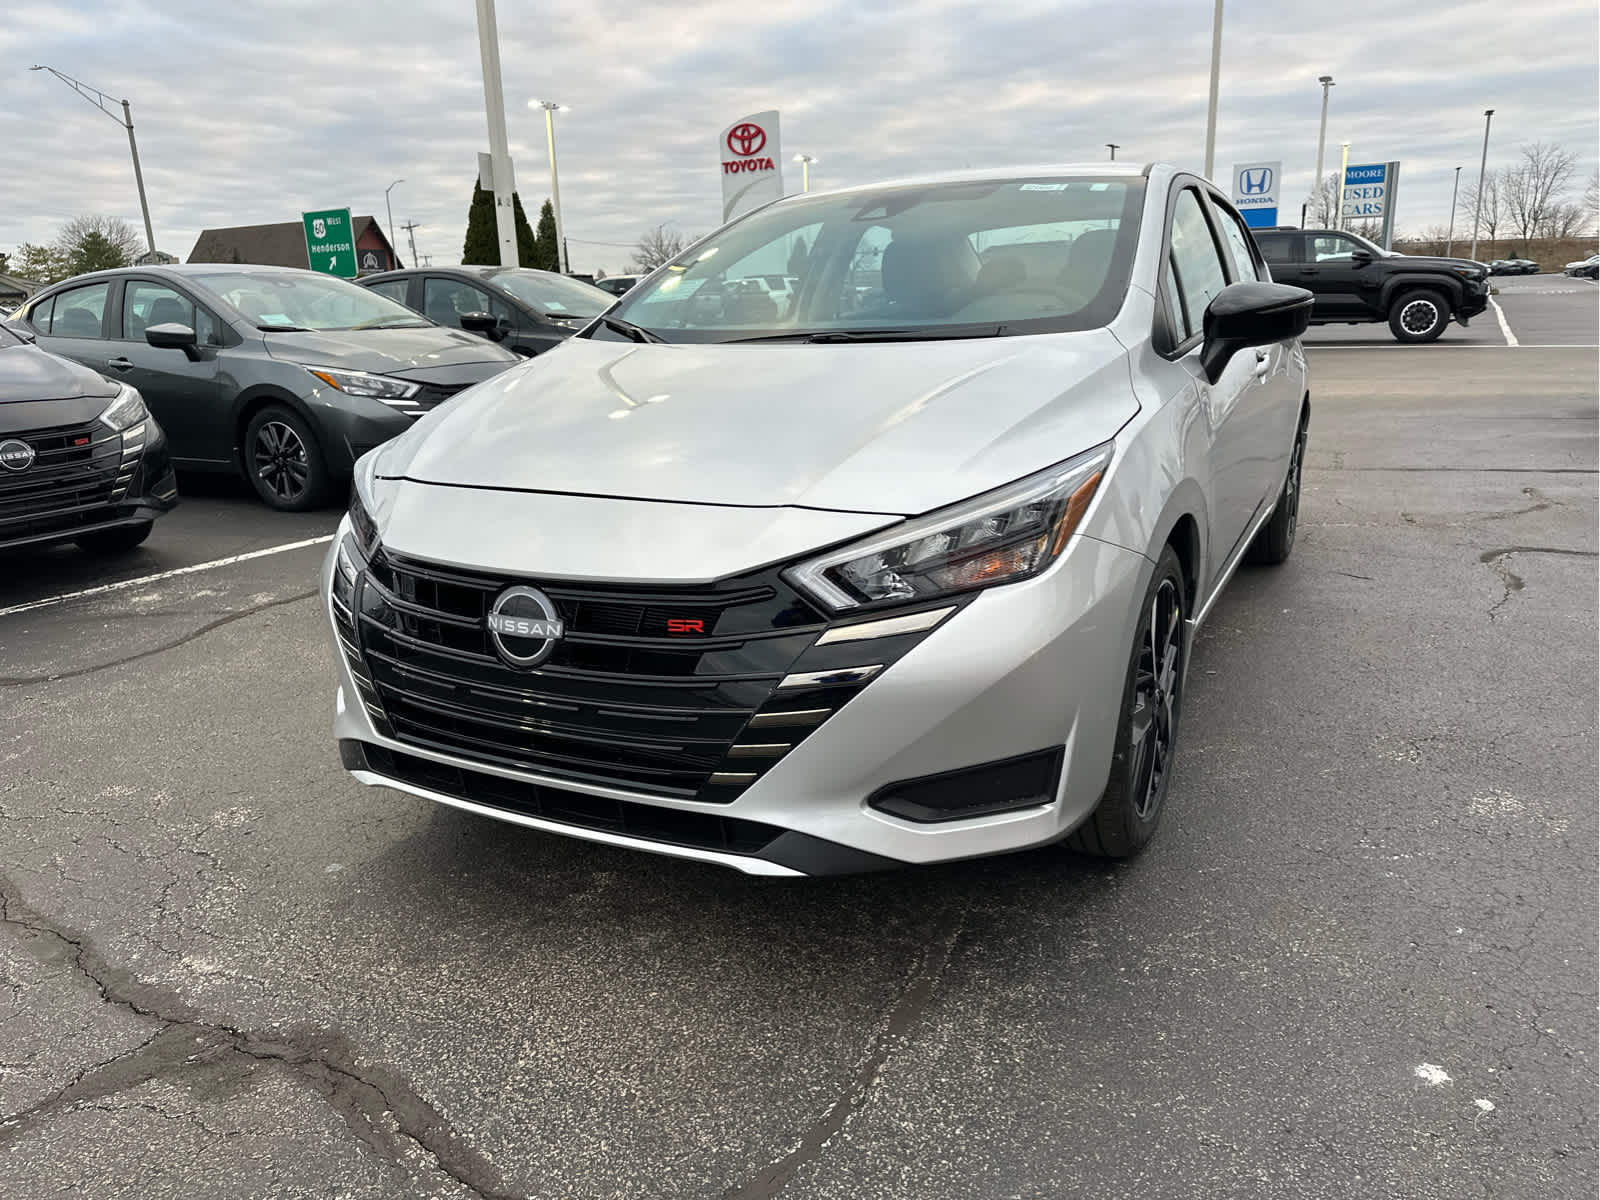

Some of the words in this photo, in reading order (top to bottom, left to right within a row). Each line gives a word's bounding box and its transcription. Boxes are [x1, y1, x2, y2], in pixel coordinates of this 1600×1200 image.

[722, 157, 775, 174] TOYOTA
[1346, 169, 1384, 178] MOORE
[1343, 186, 1384, 200] USED
[1236, 197, 1273, 205] HONDA
[1342, 203, 1382, 215] CARS
[314, 222, 325, 235] 60
[311, 243, 351, 253] Henderson
[0, 449, 36, 461] ISSAN
[487, 615, 561, 637] NISSAN
[667, 619, 705, 632] SR
